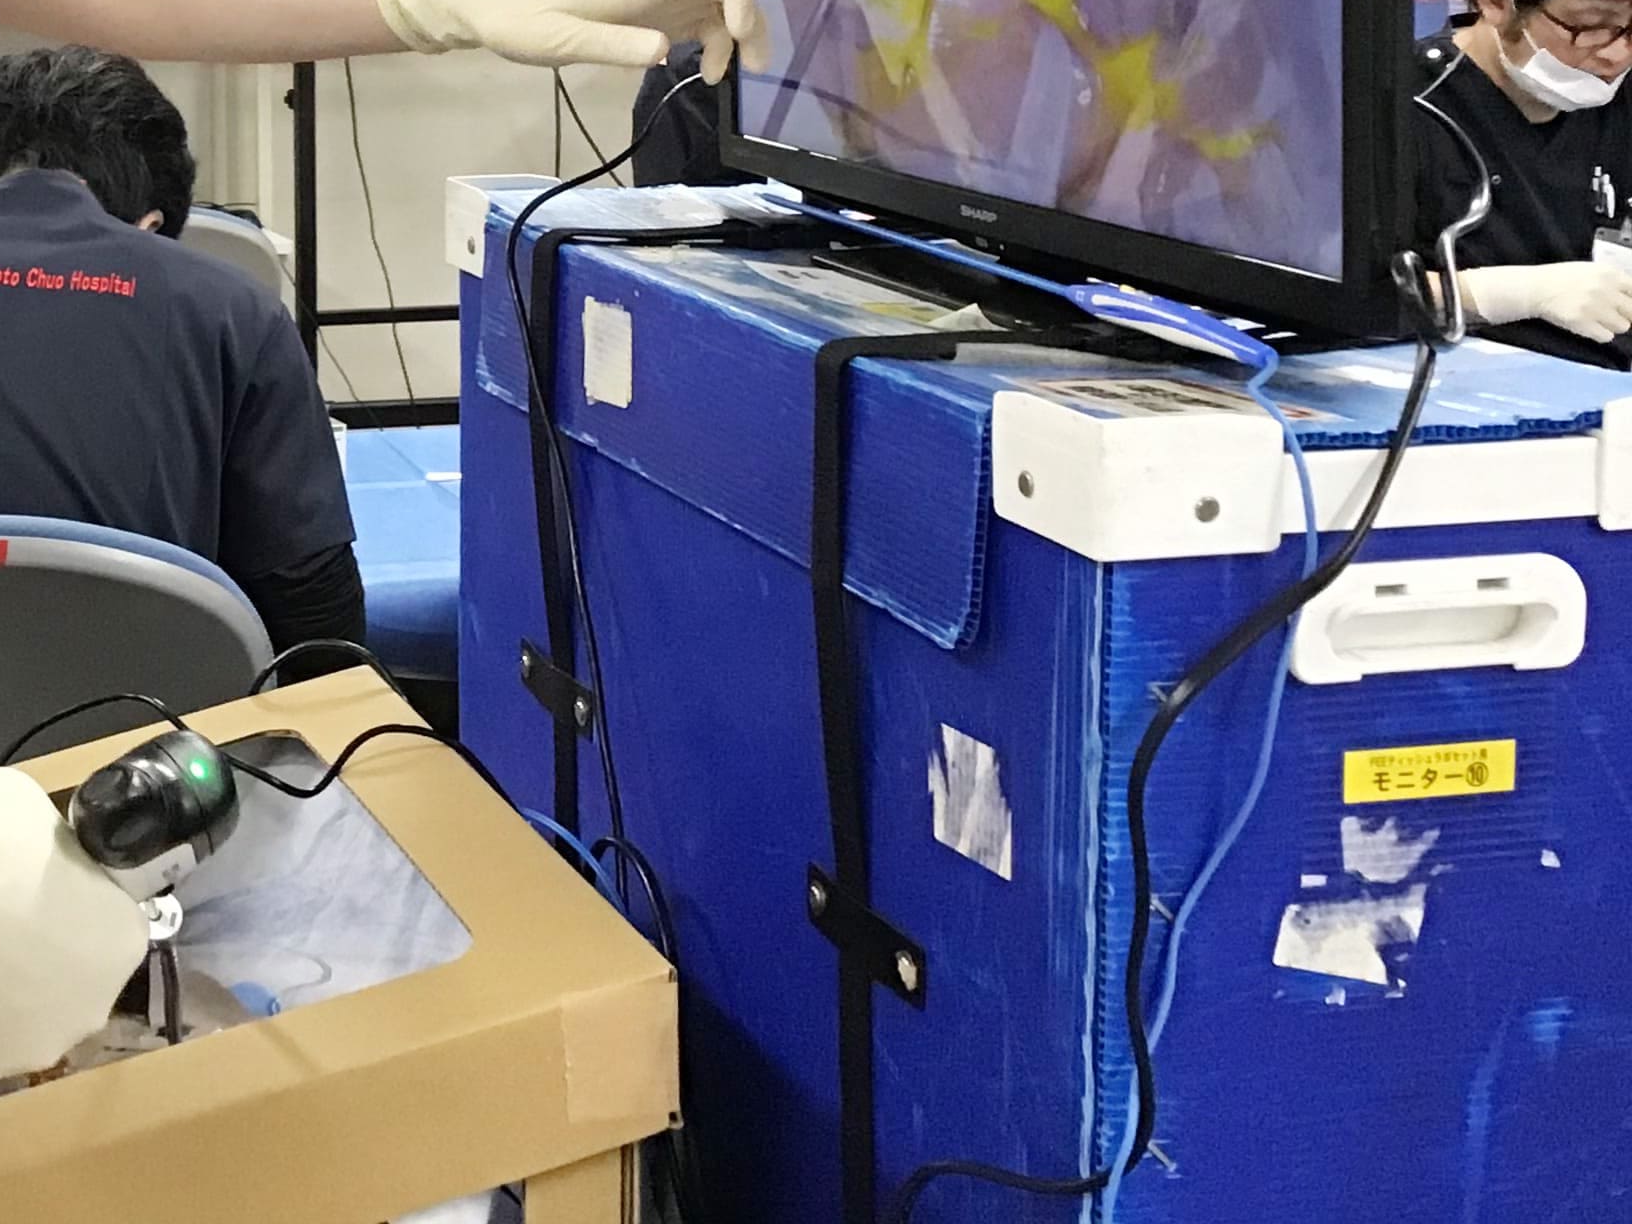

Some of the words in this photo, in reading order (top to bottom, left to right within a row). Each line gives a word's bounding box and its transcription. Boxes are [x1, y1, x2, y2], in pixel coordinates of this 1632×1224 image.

[959, 204, 997, 223] SHARP
[26, 267, 65, 290] Chuo
[70, 270, 137, 297] Hospital
